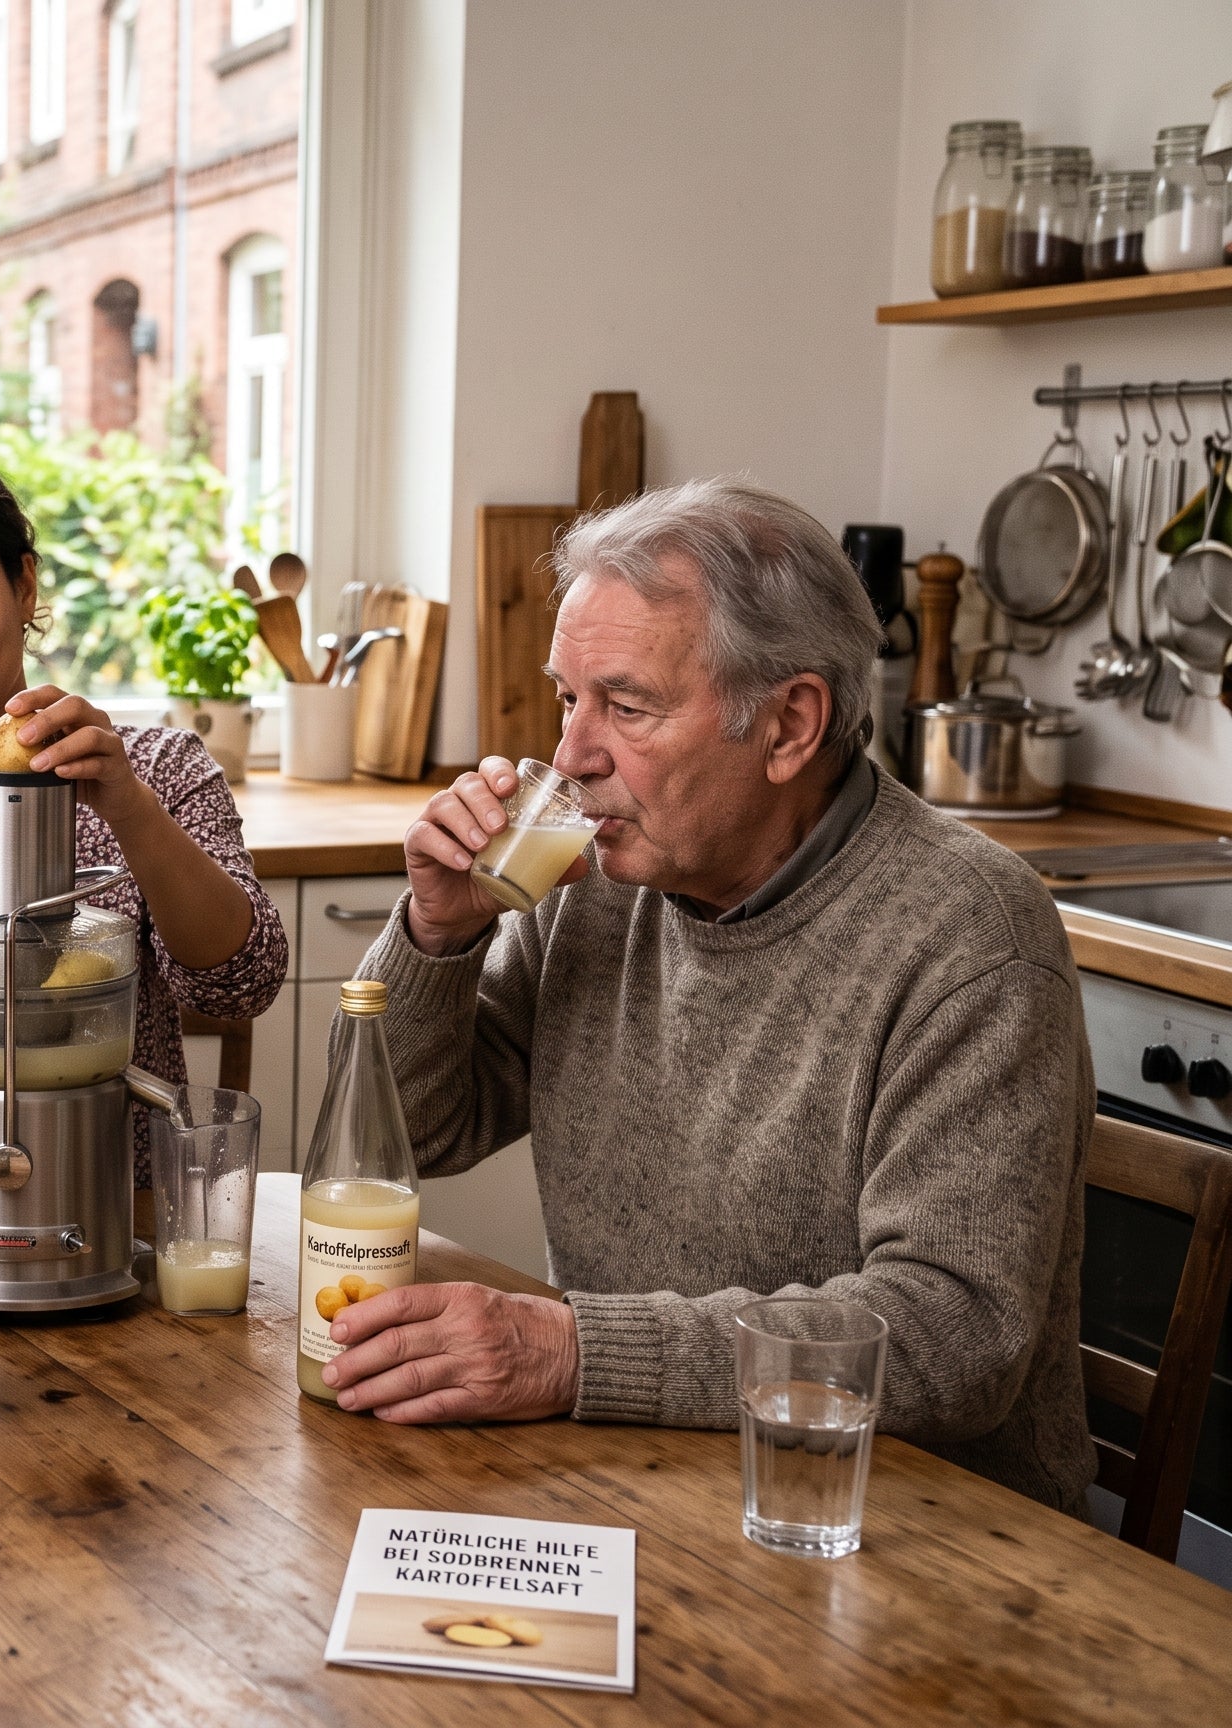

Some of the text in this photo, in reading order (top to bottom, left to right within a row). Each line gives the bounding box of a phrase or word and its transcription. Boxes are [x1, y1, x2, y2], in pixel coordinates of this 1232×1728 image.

[308, 1235, 410, 1262] Kartoffelpresssaft
[389, 1528, 599, 1559] NATÜRLICHE HILFE
[383, 1547, 419, 1561] BEI
[428, 1550, 581, 1577] SODBRENNEN
[395, 1567, 584, 1597] KARTOFFELSAFT
